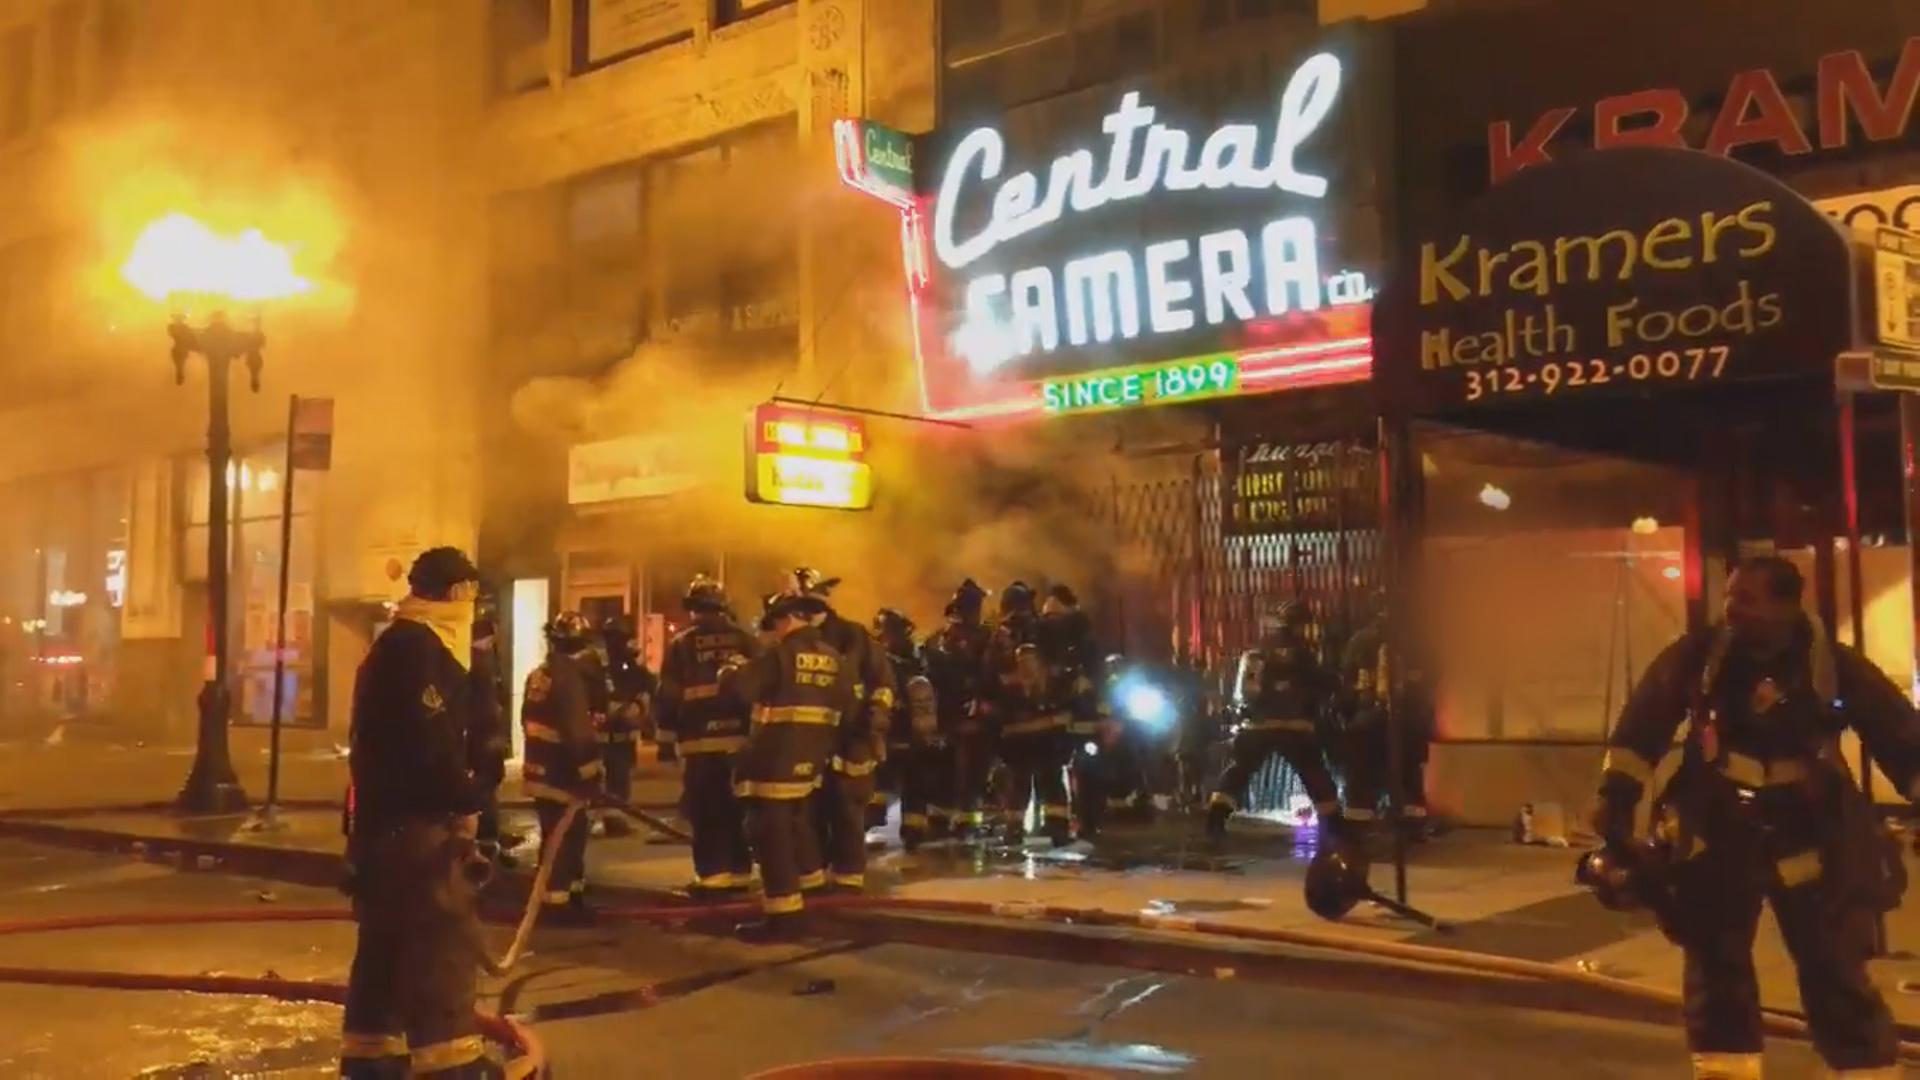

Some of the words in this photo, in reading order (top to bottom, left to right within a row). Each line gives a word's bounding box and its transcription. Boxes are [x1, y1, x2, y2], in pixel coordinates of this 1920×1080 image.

[865, 127, 913, 174] Central
[934, 51, 1342, 269] Central
[960, 215, 1320, 366] CAMERA
[1419, 201, 1777, 304] Kramers
[1421, 304, 1576, 370] Health
[1606, 280, 1782, 348] Foods
[1043, 375, 1141, 411] SINCE
[1153, 360, 1228, 398] 1899
[1466, 345, 1730, 400] 312-922-0077
